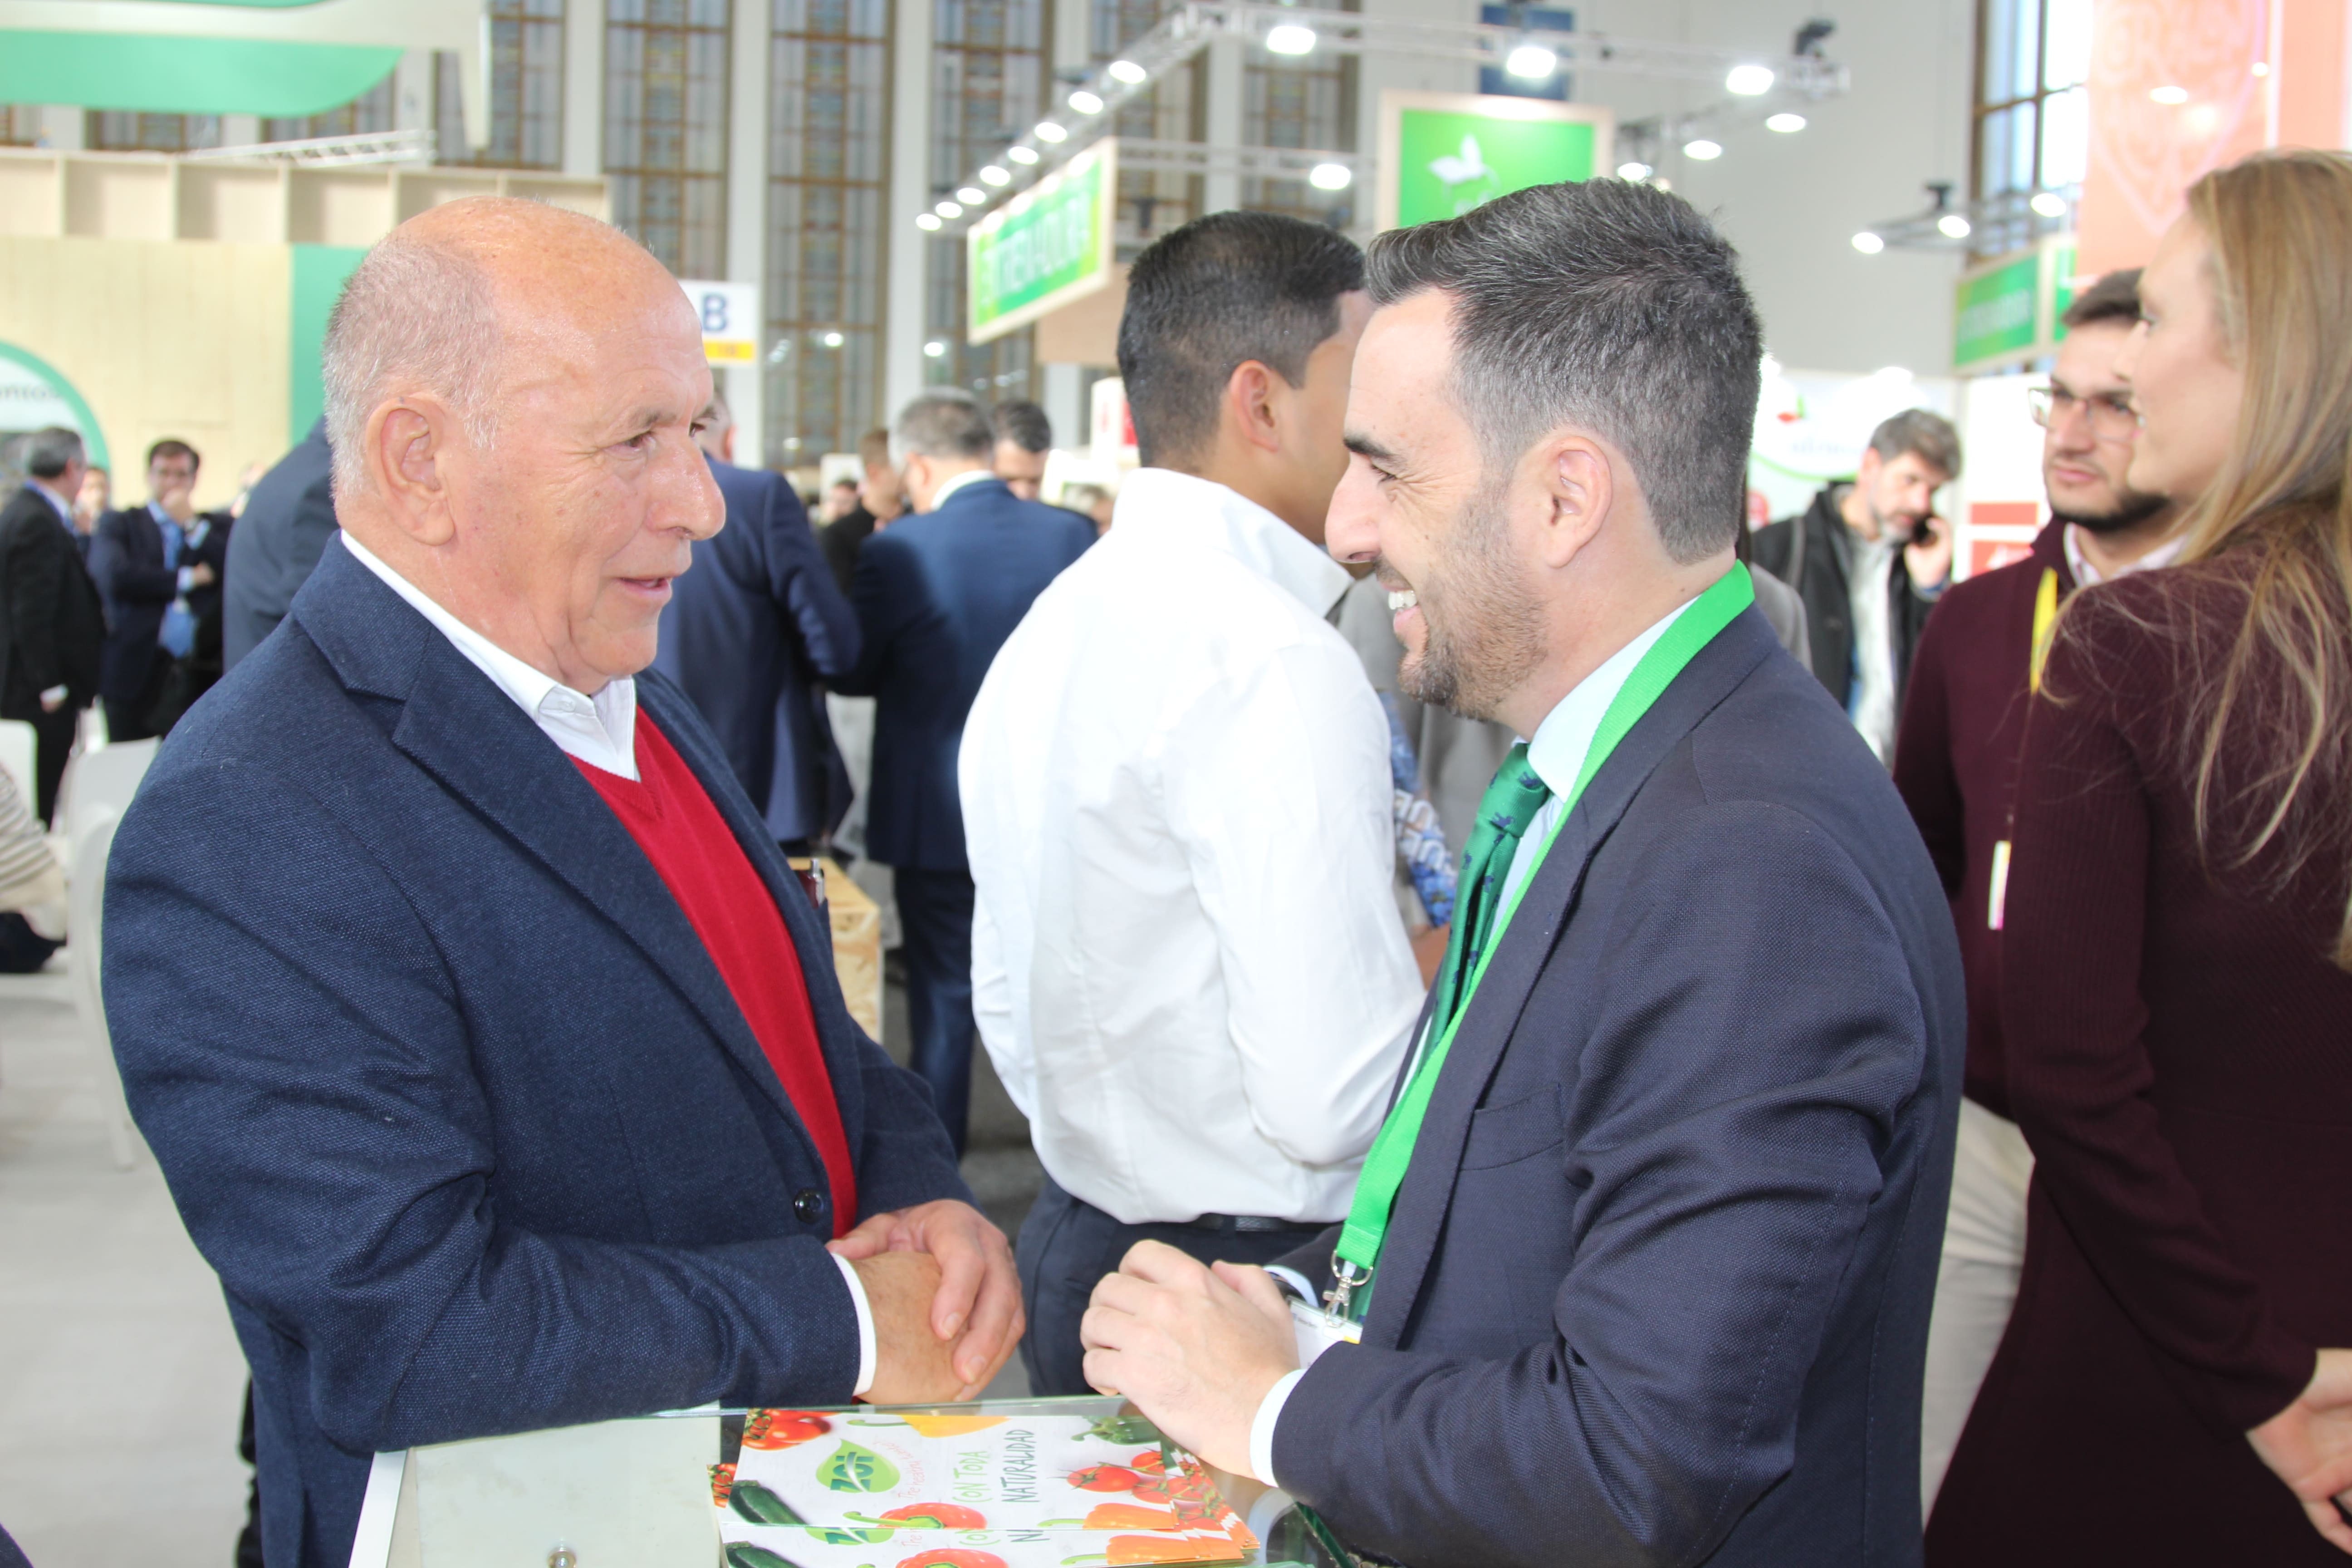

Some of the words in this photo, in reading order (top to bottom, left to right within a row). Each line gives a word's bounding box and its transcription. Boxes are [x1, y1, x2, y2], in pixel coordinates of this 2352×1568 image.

[702, 293, 728, 332] B
[908, 1460, 926, 1486] healthy
[953, 1450, 991, 1479] TODA
[1000, 1429, 1040, 1503] NATURALIDAD
[897, 1487, 921, 1499] The
